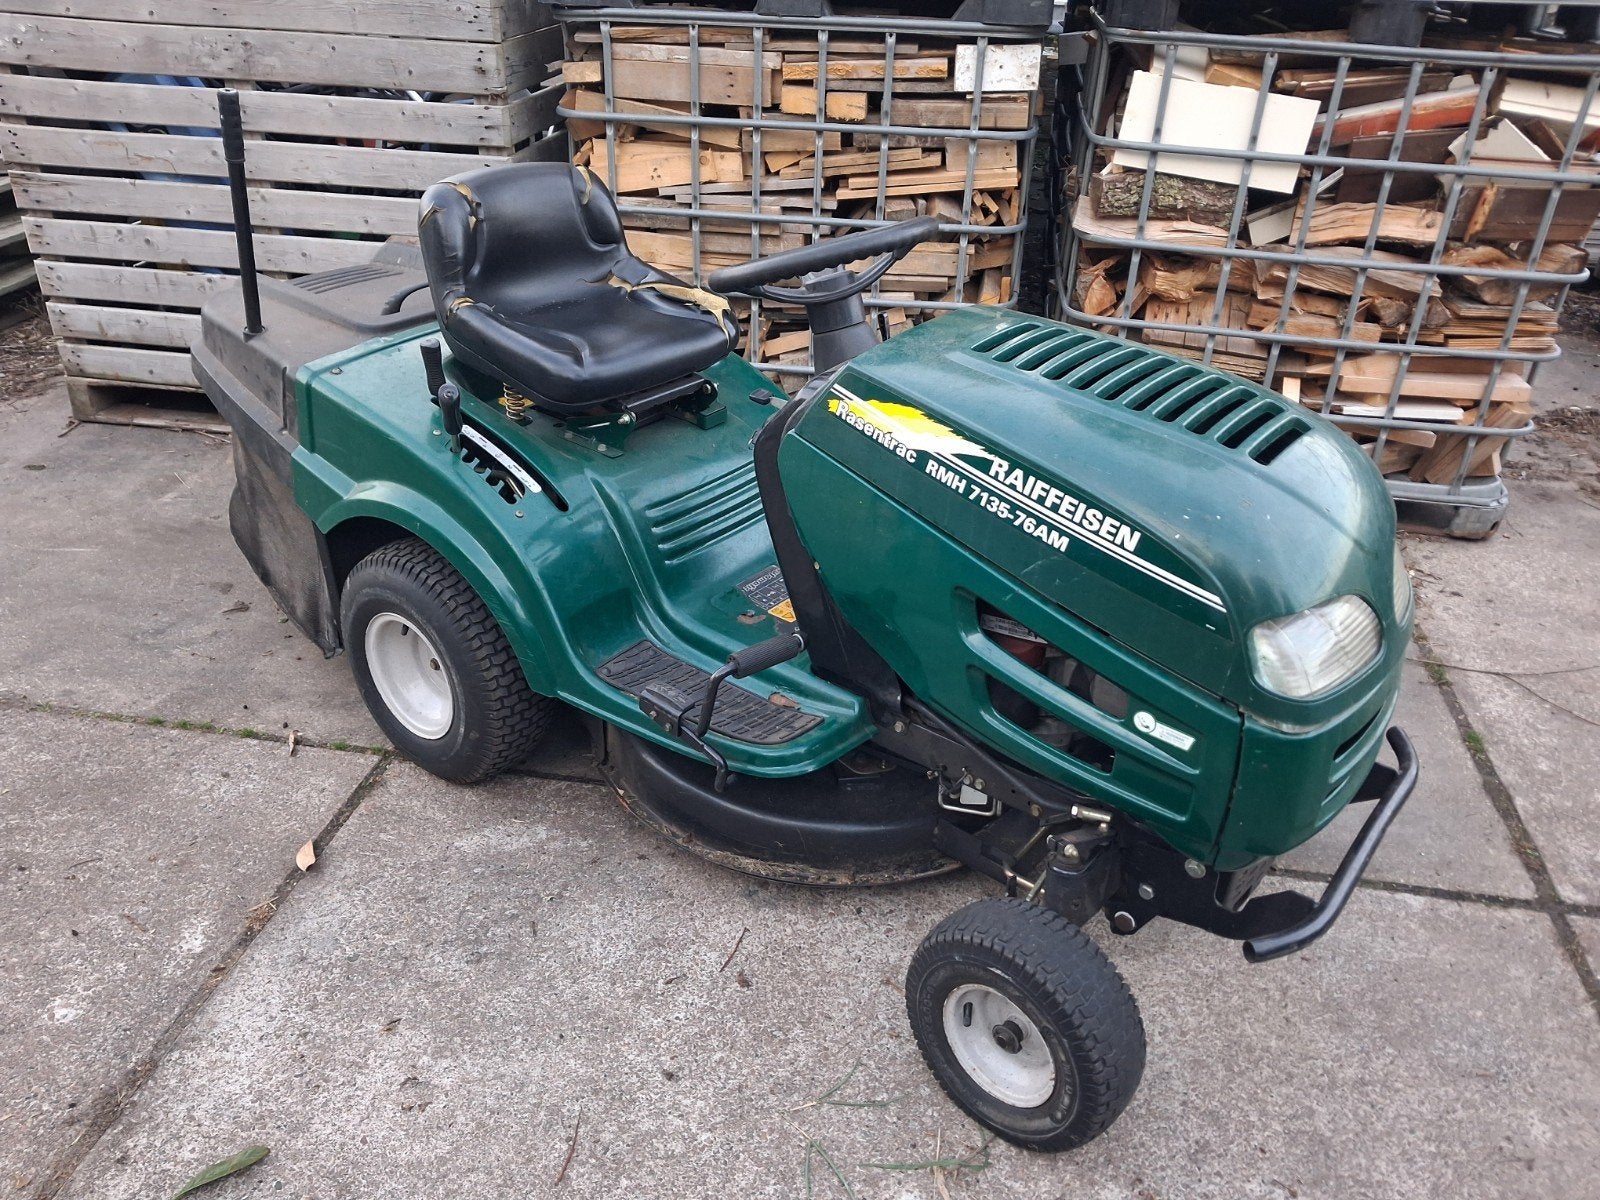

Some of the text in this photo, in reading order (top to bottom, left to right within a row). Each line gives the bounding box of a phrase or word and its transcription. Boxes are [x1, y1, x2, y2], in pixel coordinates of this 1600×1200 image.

[835, 399, 1070, 552] Rasentrac RMH 7135-76AM
[988, 456, 1141, 552] RAIFFEISEN
